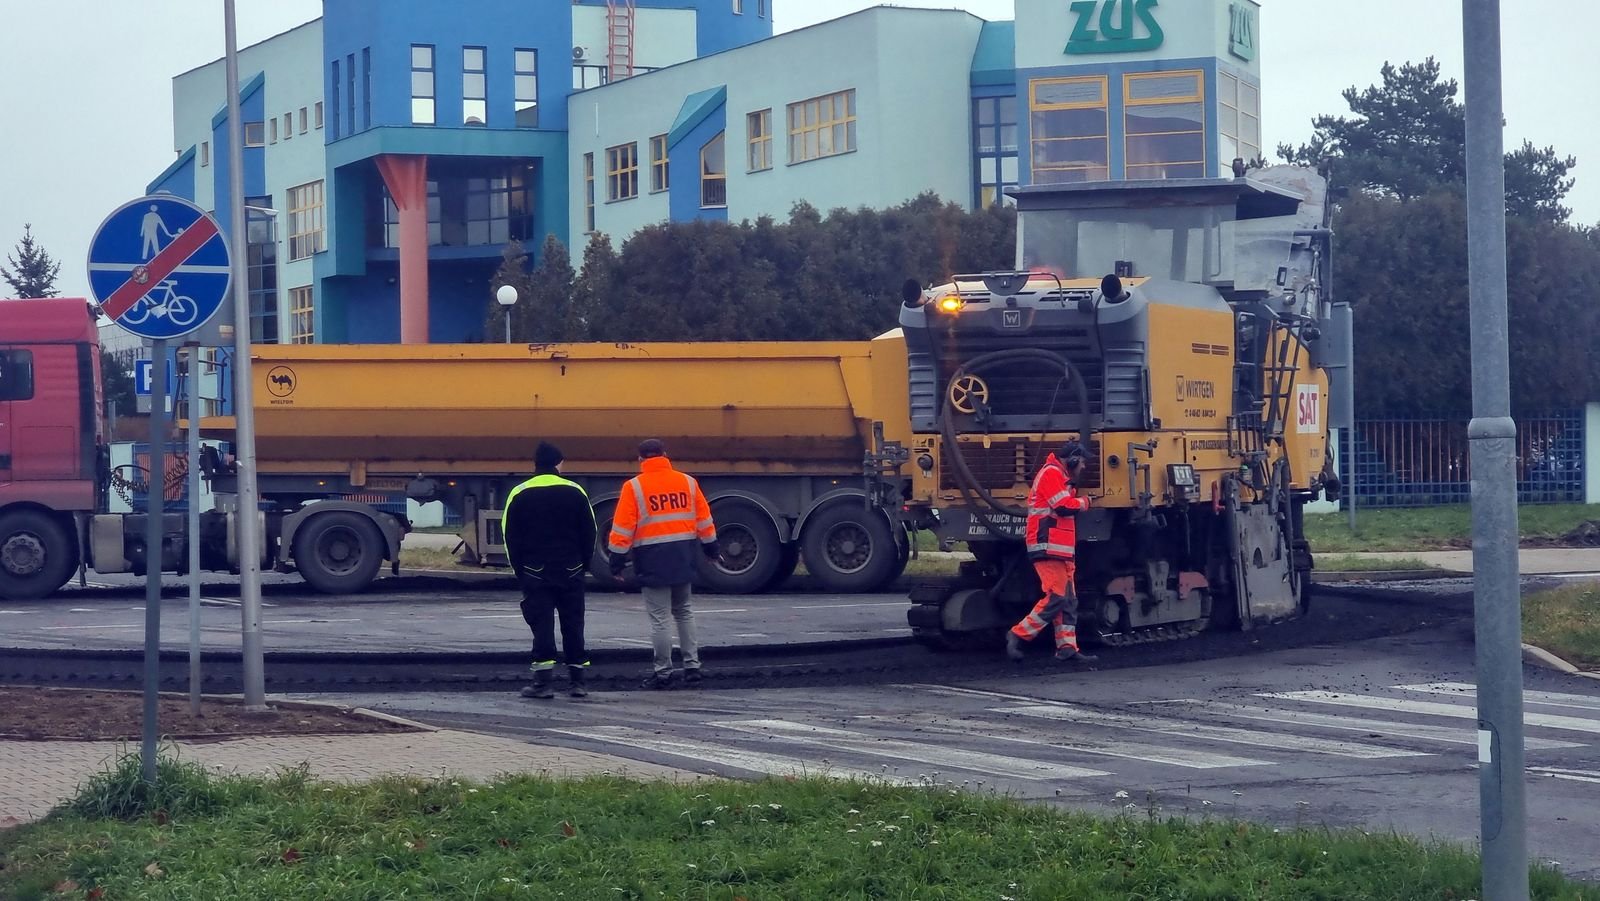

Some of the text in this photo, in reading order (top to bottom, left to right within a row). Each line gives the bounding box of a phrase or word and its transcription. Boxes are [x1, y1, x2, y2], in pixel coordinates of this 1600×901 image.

[1063, 0, 1165, 54] ZUS
[1186, 380, 1215, 398] WIRTGEN
[1299, 392, 1317, 426] SAT
[648, 492, 687, 511] SPRD
